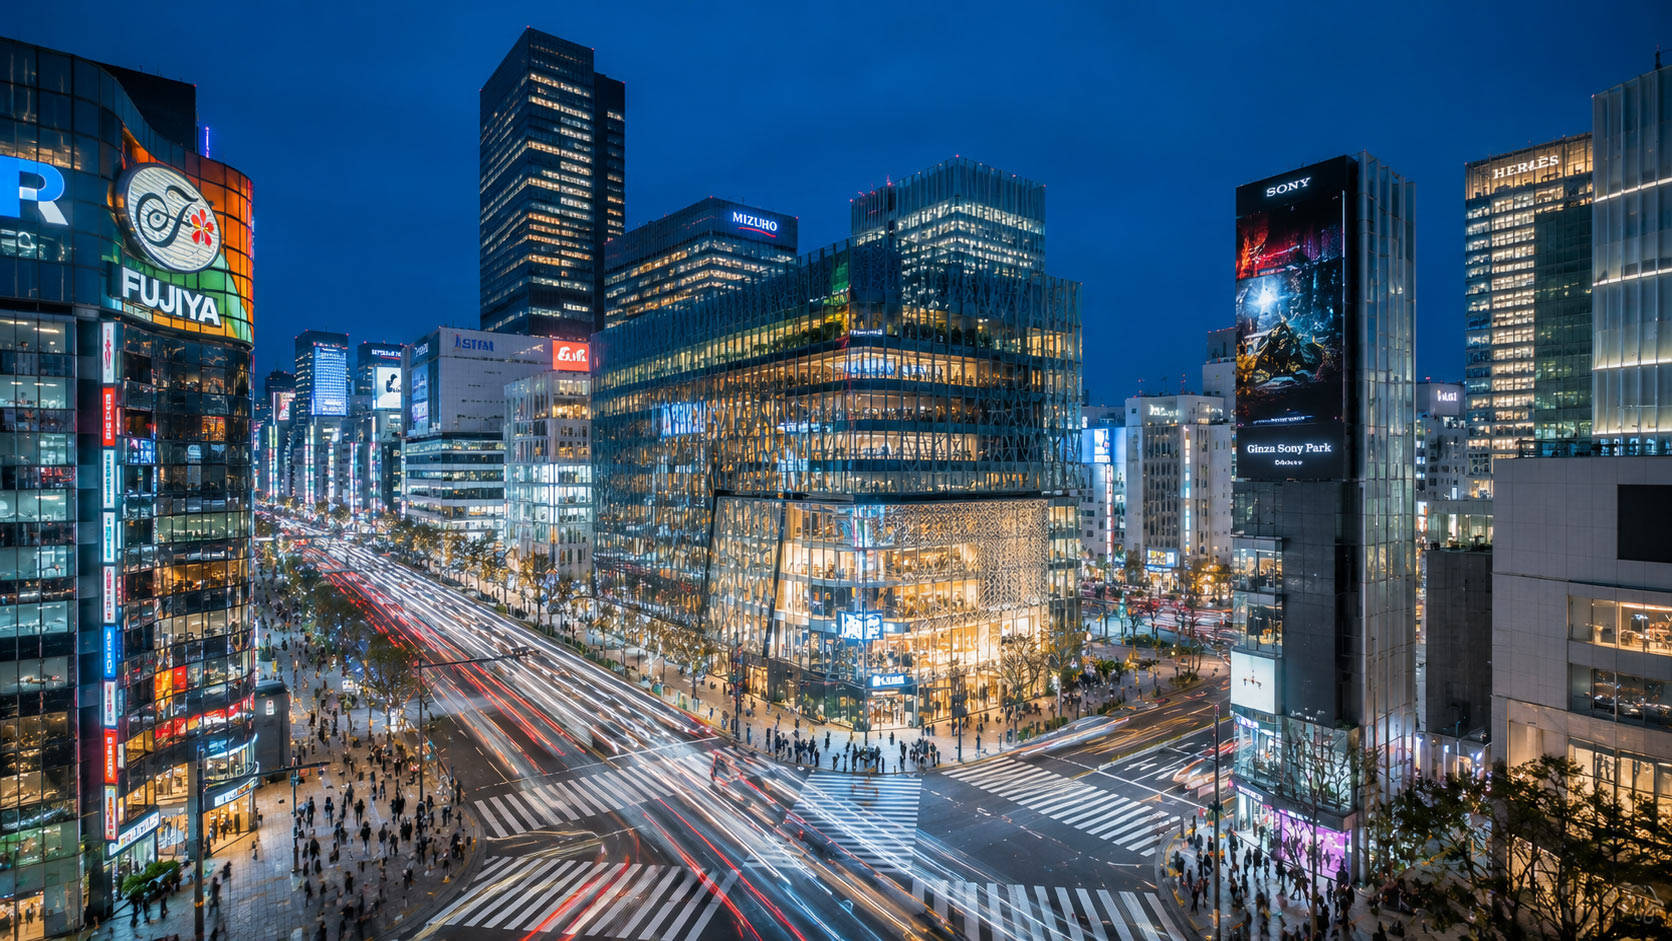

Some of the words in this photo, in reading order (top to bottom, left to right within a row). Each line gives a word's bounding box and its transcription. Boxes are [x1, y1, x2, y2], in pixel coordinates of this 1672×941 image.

[1266, 176, 1311, 197] SONY
[733, 211, 777, 232] MIZUHO
[122, 266, 221, 327] FUJIYA
[1247, 444, 1276, 453] Ginza
[1277, 443, 1303, 455] Sony
[1305, 443, 1332, 453] Park
